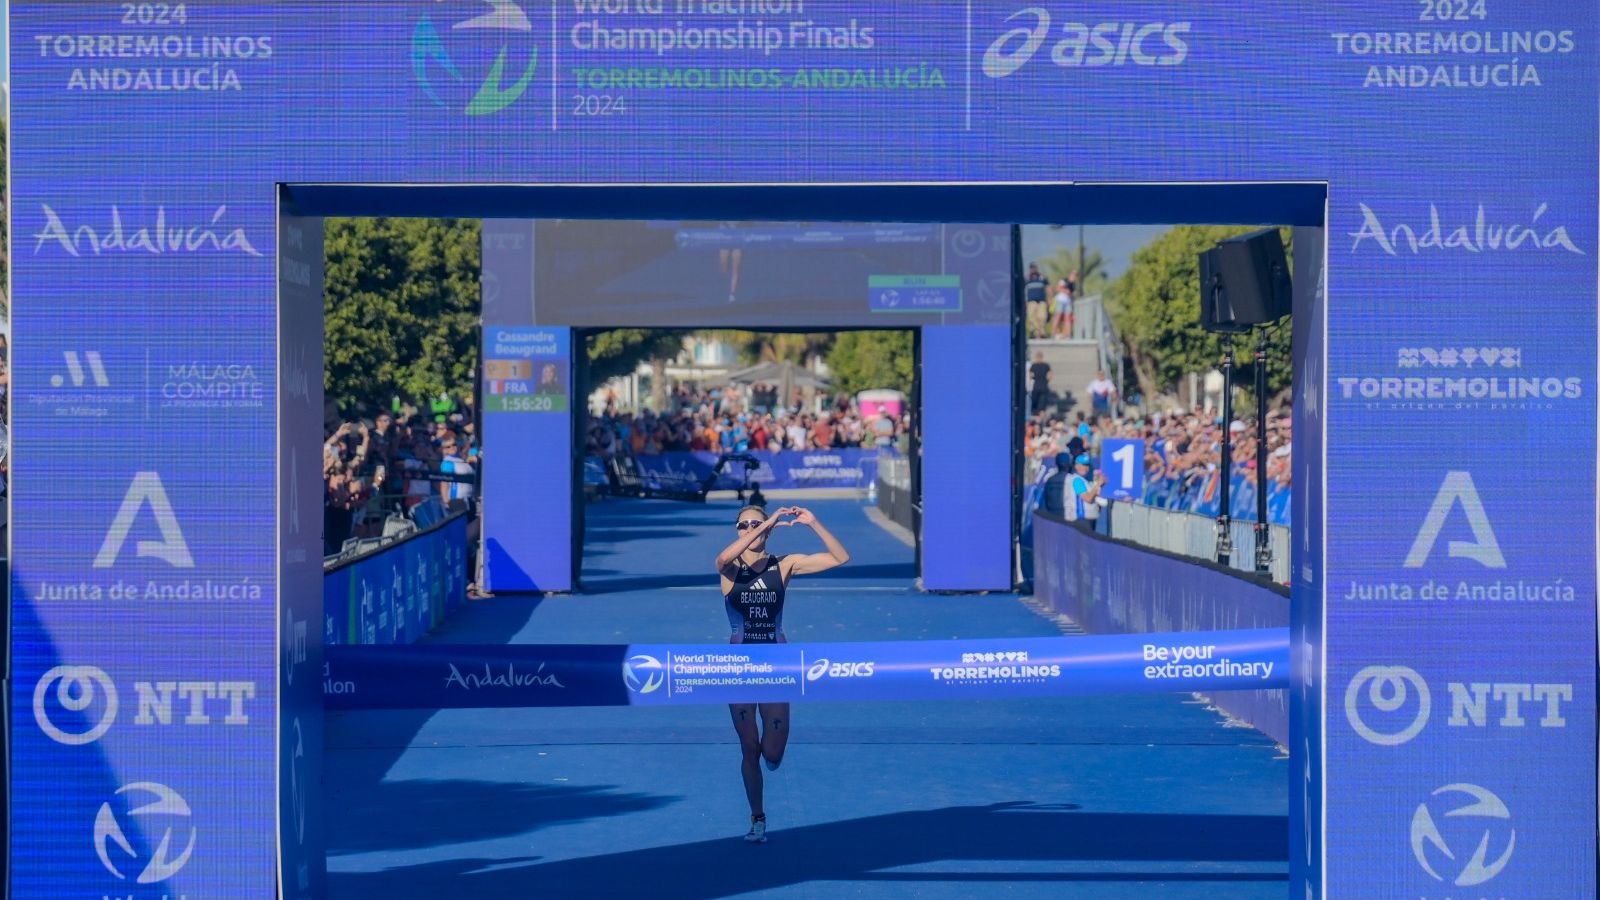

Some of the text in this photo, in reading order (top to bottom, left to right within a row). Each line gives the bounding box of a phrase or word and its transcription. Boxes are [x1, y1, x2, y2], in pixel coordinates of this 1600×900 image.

[121, 2, 188, 25] 2024
[1418, 0, 1488, 20] 2024
[34, 35, 273, 58] TORREMOLINOS
[571, 19, 875, 56] Championship Finals
[1331, 30, 1574, 54] TORREMOLINOS
[66, 61, 242, 91] ANDALUCÍA
[572, 62, 947, 89] TORREMOLINOS-ANDALUCÍA
[1363, 58, 1542, 88] ANDALUCÍA
[573, 95, 627, 116] 2024
[33, 203, 264, 257] Andalucía
[1347, 201, 1587, 257] Andalucía
[497, 331, 555, 343] Cassandre
[495, 343, 557, 356] Beaugrand
[168, 360, 257, 380] MÁLAGA
[511, 365, 518, 377] 1
[161, 381, 264, 399] COMPITE
[504, 381, 528, 394] FRA
[1338, 377, 1582, 399] TORREMOLINOS
[501, 398, 552, 411] 1:56:20
[1112, 444, 1135, 489] 1
[35, 576, 262, 600] Junta de Andalucía
[740, 591, 777, 604] BEAUGRAND
[1344, 577, 1575, 601] Junta de Andalucía
[749, 606, 769, 618] FRA
[674, 654, 750, 663] World Triathlon
[1143, 644, 1215, 664] Be your
[444, 661, 566, 690] Andalucía
[673, 662, 773, 675] Championship Finals
[930, 664, 1061, 680] TORREMOLINOS
[1144, 659, 1274, 680] extraordinary
[675, 675, 797, 686] TORREMOLINOS-ANDALUCÍA
[675, 685, 693, 693] 2024
[134, 681, 256, 725] NTT
[1448, 683, 1573, 727] NTT
